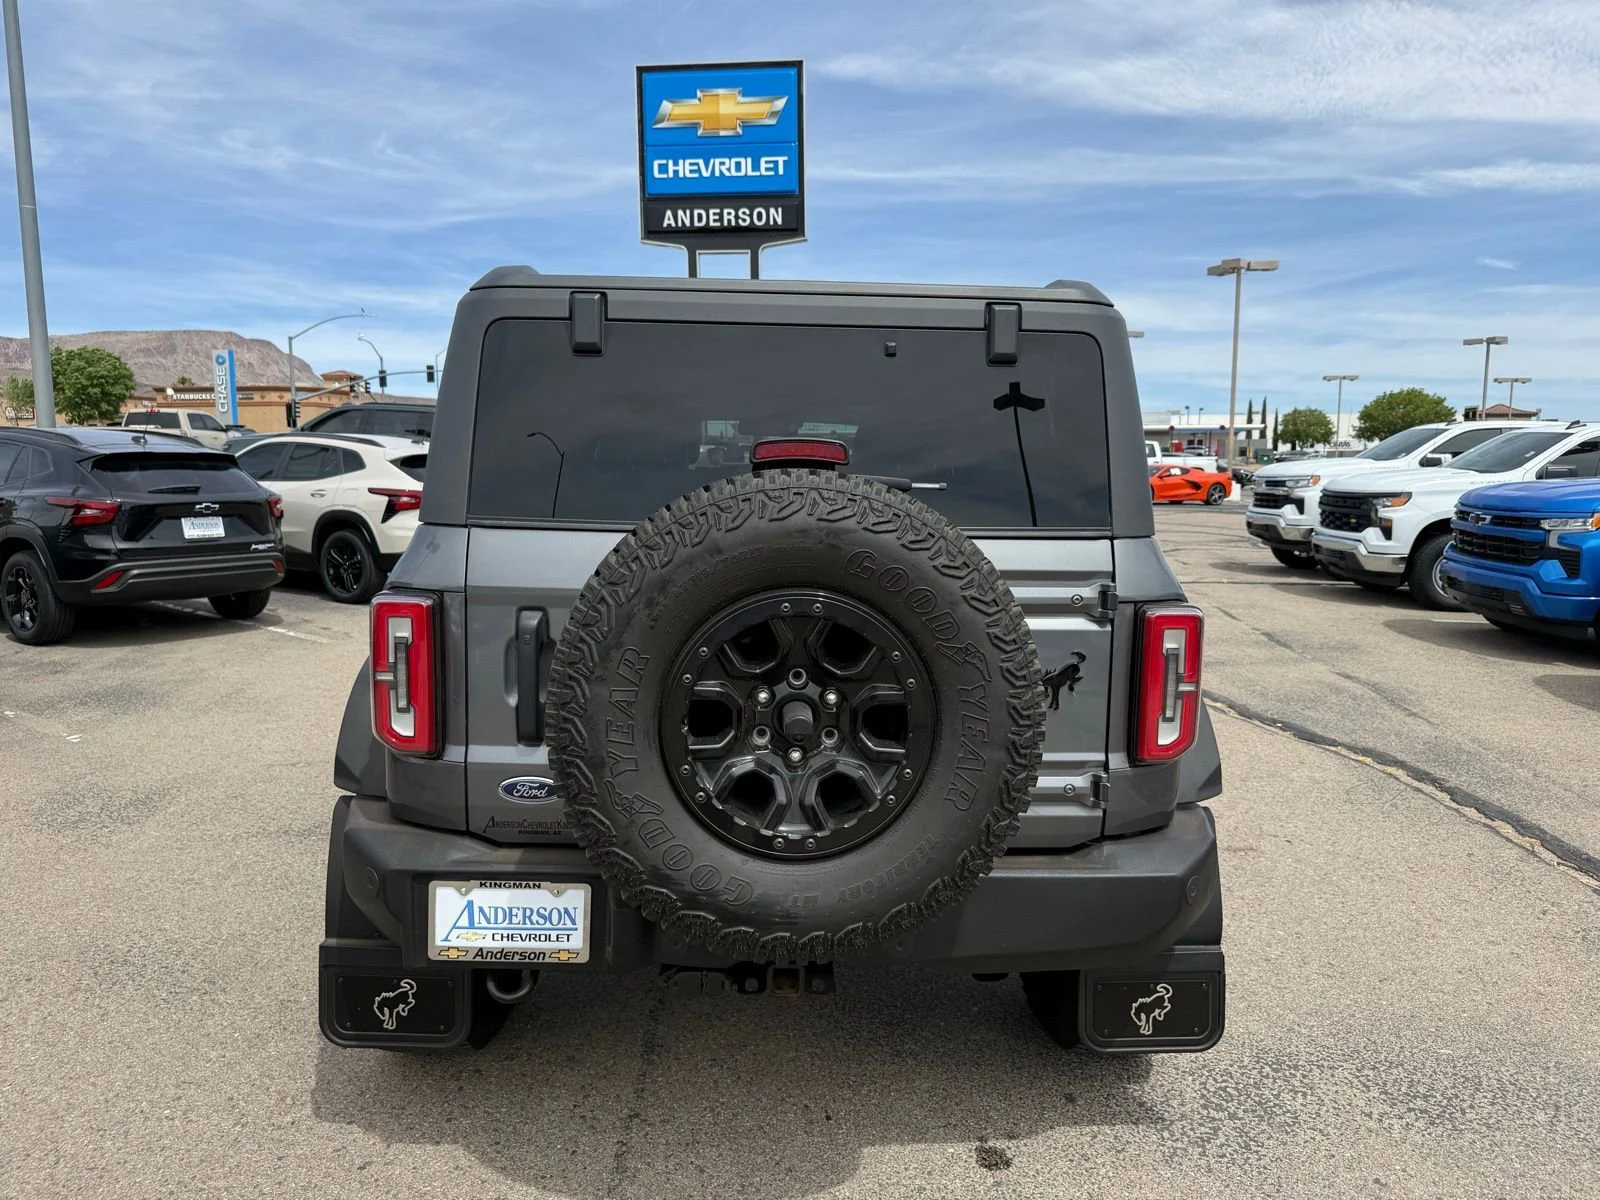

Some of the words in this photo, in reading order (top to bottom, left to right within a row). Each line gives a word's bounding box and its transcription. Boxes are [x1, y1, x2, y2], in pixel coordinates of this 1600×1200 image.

[653, 156, 788, 179] CHEVROLET
[663, 207, 783, 228] ANDERSON
[216, 367, 228, 413] CHASE
[513, 783, 548, 798] Ford
[479, 880, 541, 889] KINGMAN
[440, 899, 577, 942] ANDERSON
[492, 932, 573, 943] CHEVROLET
[472, 948, 546, 961] Anderson
